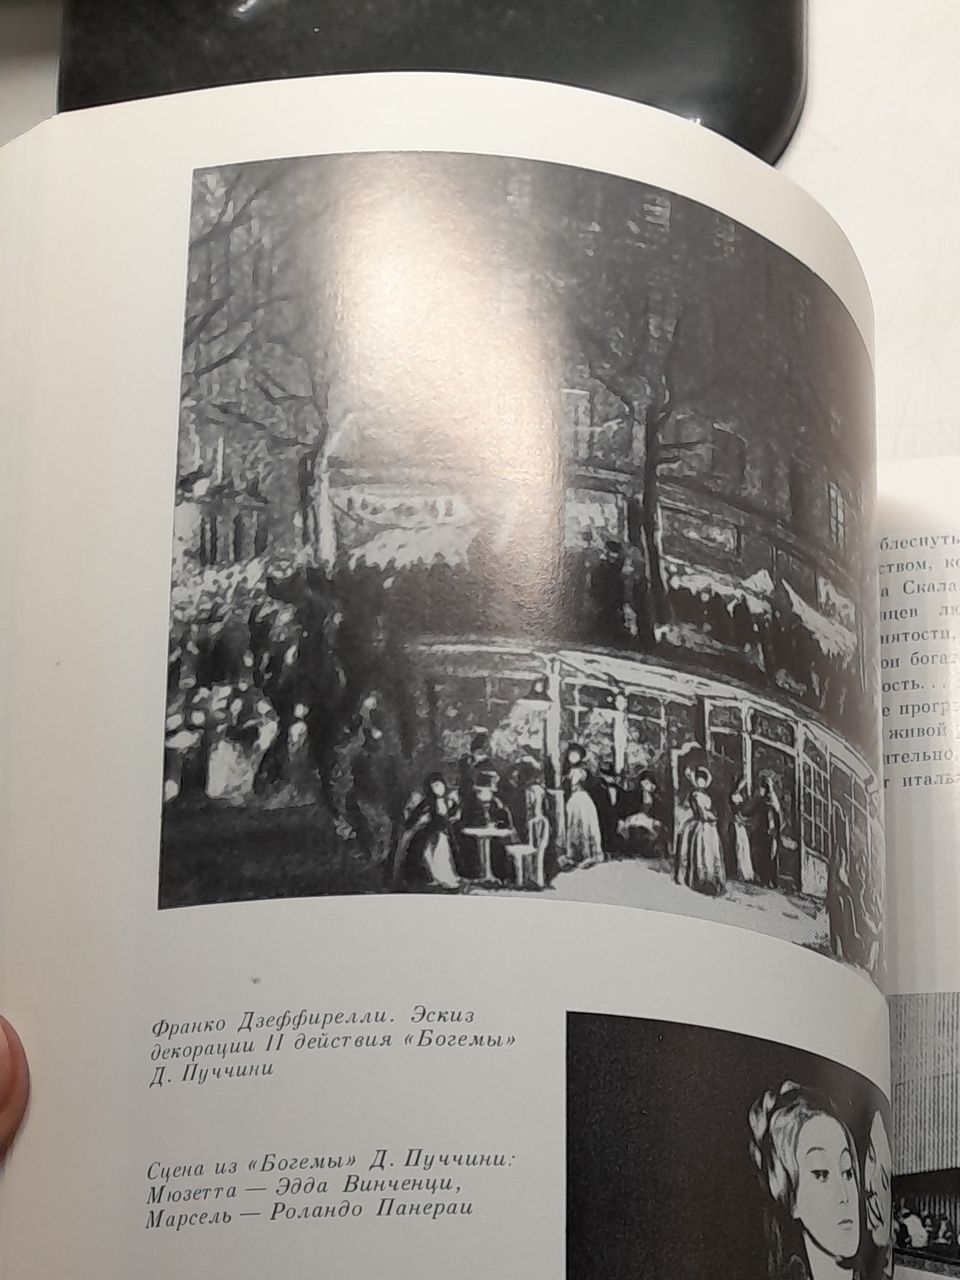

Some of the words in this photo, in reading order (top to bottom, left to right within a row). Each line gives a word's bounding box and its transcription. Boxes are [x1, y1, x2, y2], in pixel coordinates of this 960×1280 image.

[880, 535, 960, 551] блеснуть
[879, 560, 932, 575] ством,
[880, 629, 955, 645] нятости,
[889, 722, 947, 740] живой
[152, 1019, 225, 1040] Франко
[237, 1009, 394, 1035] Дзеффирелли.
[411, 1005, 474, 1023] Эскиз
[151, 1041, 254, 1062] декорации
[294, 1033, 392, 1052] действия
[405, 1029, 515, 1047] «Богемы»
[149, 1066, 171, 1088] Д.
[182, 1063, 273, 1085] Пуччини
[147, 1162, 204, 1183] Сцена
[215, 1162, 237, 1175] из
[248, 1154, 356, 1172] «Богемы»
[369, 1149, 394, 1171] Д.
[404, 1149, 515, 1171] Пуччини:
[146, 1185, 236, 1205] Мюзетта
[276, 1177, 328, 1196] Эдда
[342, 1175, 460, 1195] Винченци,
[145, 1209, 231, 1231] Марсель
[270, 1200, 362, 1220] Роландо
[376, 1198, 473, 1220] Панераи
